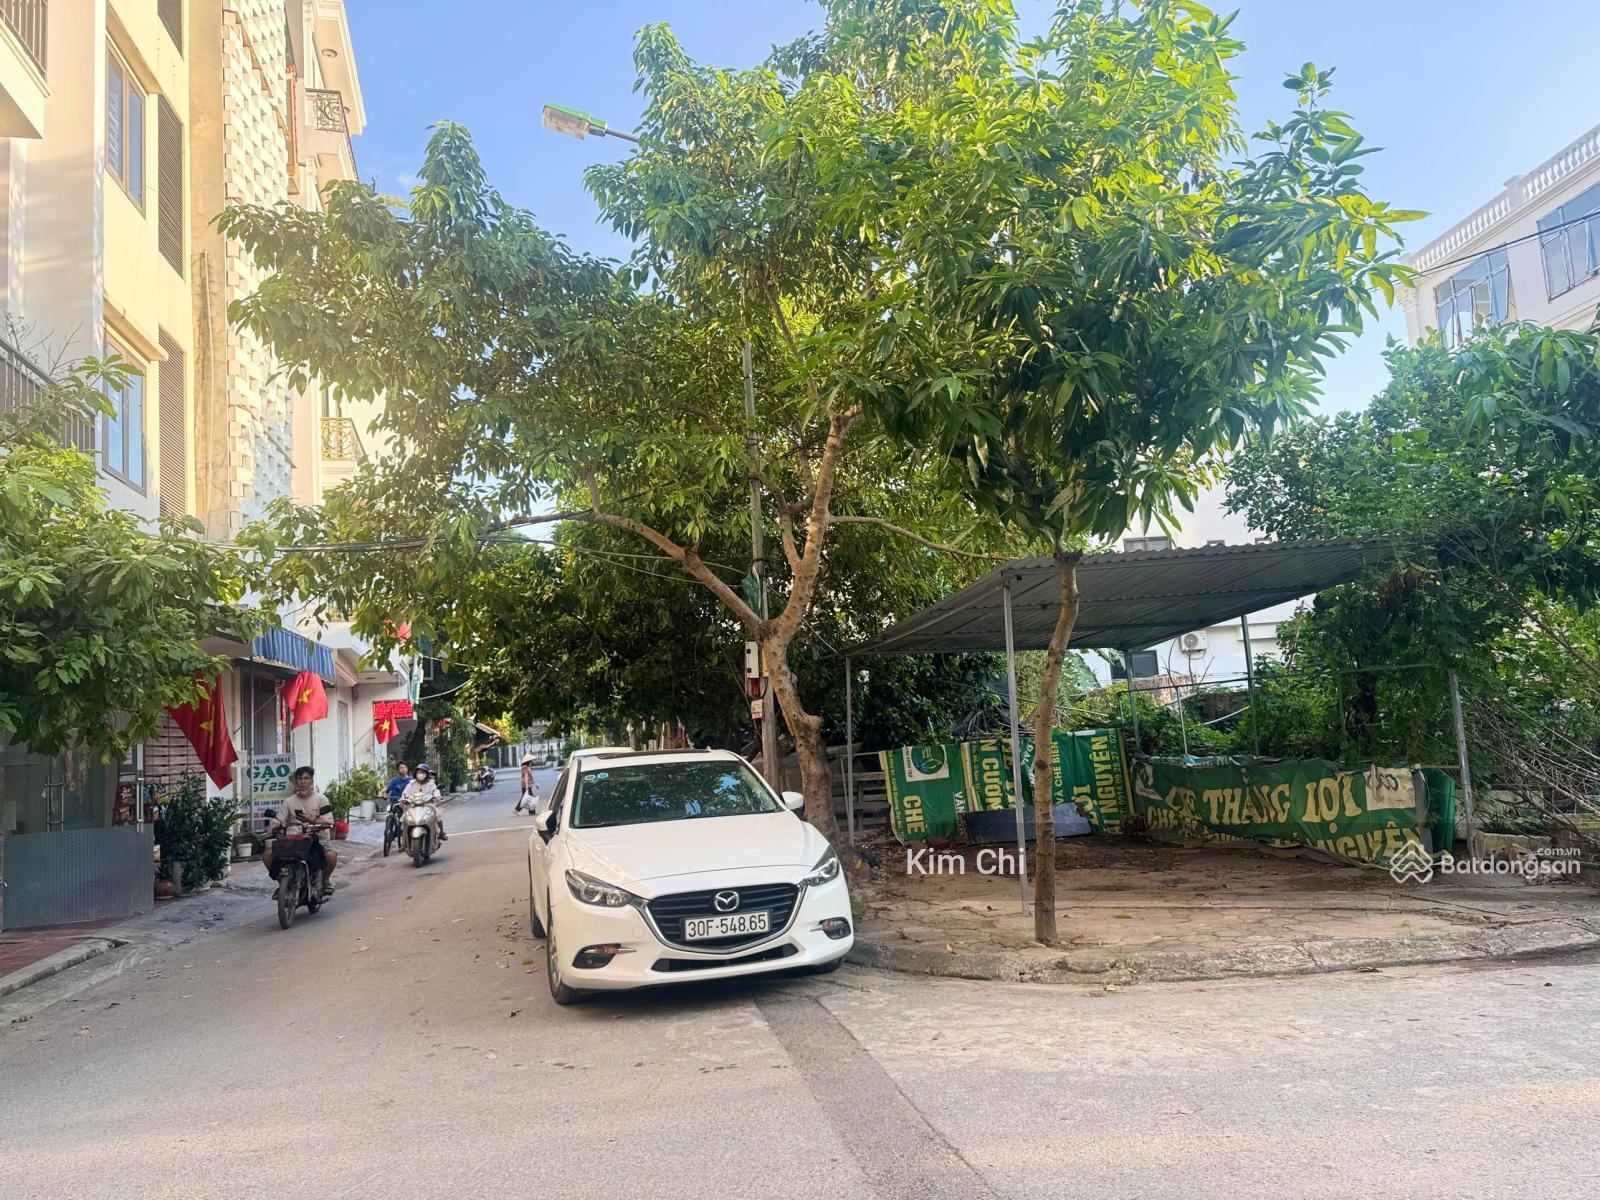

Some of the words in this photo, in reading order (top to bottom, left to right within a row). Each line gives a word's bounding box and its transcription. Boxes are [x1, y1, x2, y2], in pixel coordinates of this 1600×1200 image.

[246, 764, 291, 781] GẠO
[1089, 735, 1120, 814] NGUYÊN
[1302, 772, 1361, 834] LỢI
[687, 914, 766, 938] 30F-548.65
